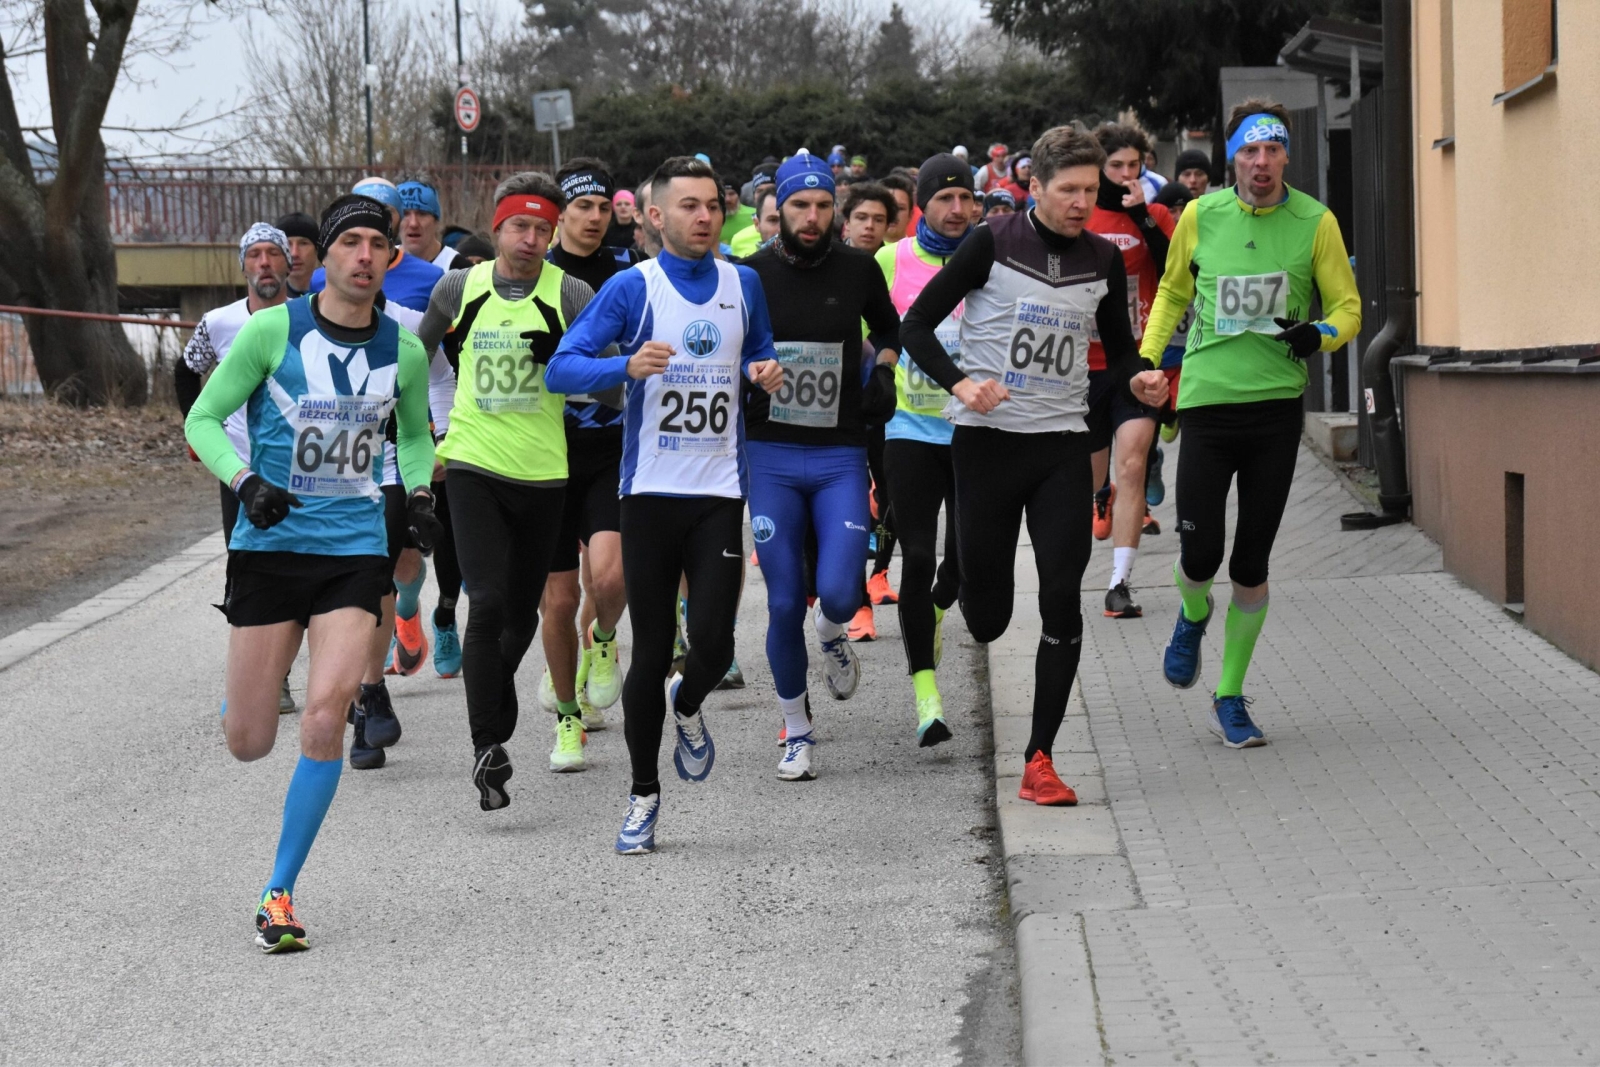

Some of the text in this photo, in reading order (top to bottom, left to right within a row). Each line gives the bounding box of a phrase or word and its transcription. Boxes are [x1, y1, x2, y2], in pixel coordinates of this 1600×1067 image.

[1220, 276, 1283, 316] 657
[1020, 302, 1050, 314] ZIMNÍ
[1018, 312, 1059, 327] BĚŽECKÁ
[1063, 320, 1080, 331] LIGA
[473, 330, 499, 340] ZIMNÍ
[473, 341, 531, 350] BĚŽECKÁ LIG
[1010, 327, 1075, 377] 640
[820, 356, 839, 365] LIGA
[475, 354, 539, 394] 632
[662, 373, 732, 384] BĚŽECKÁ LIGA
[776, 367, 838, 409] 669
[301, 399, 336, 409] ZIMNÍ
[659, 390, 730, 434] 256
[299, 410, 379, 423] BĚŽECKÁ LIGA
[296, 426, 373, 475] 646
